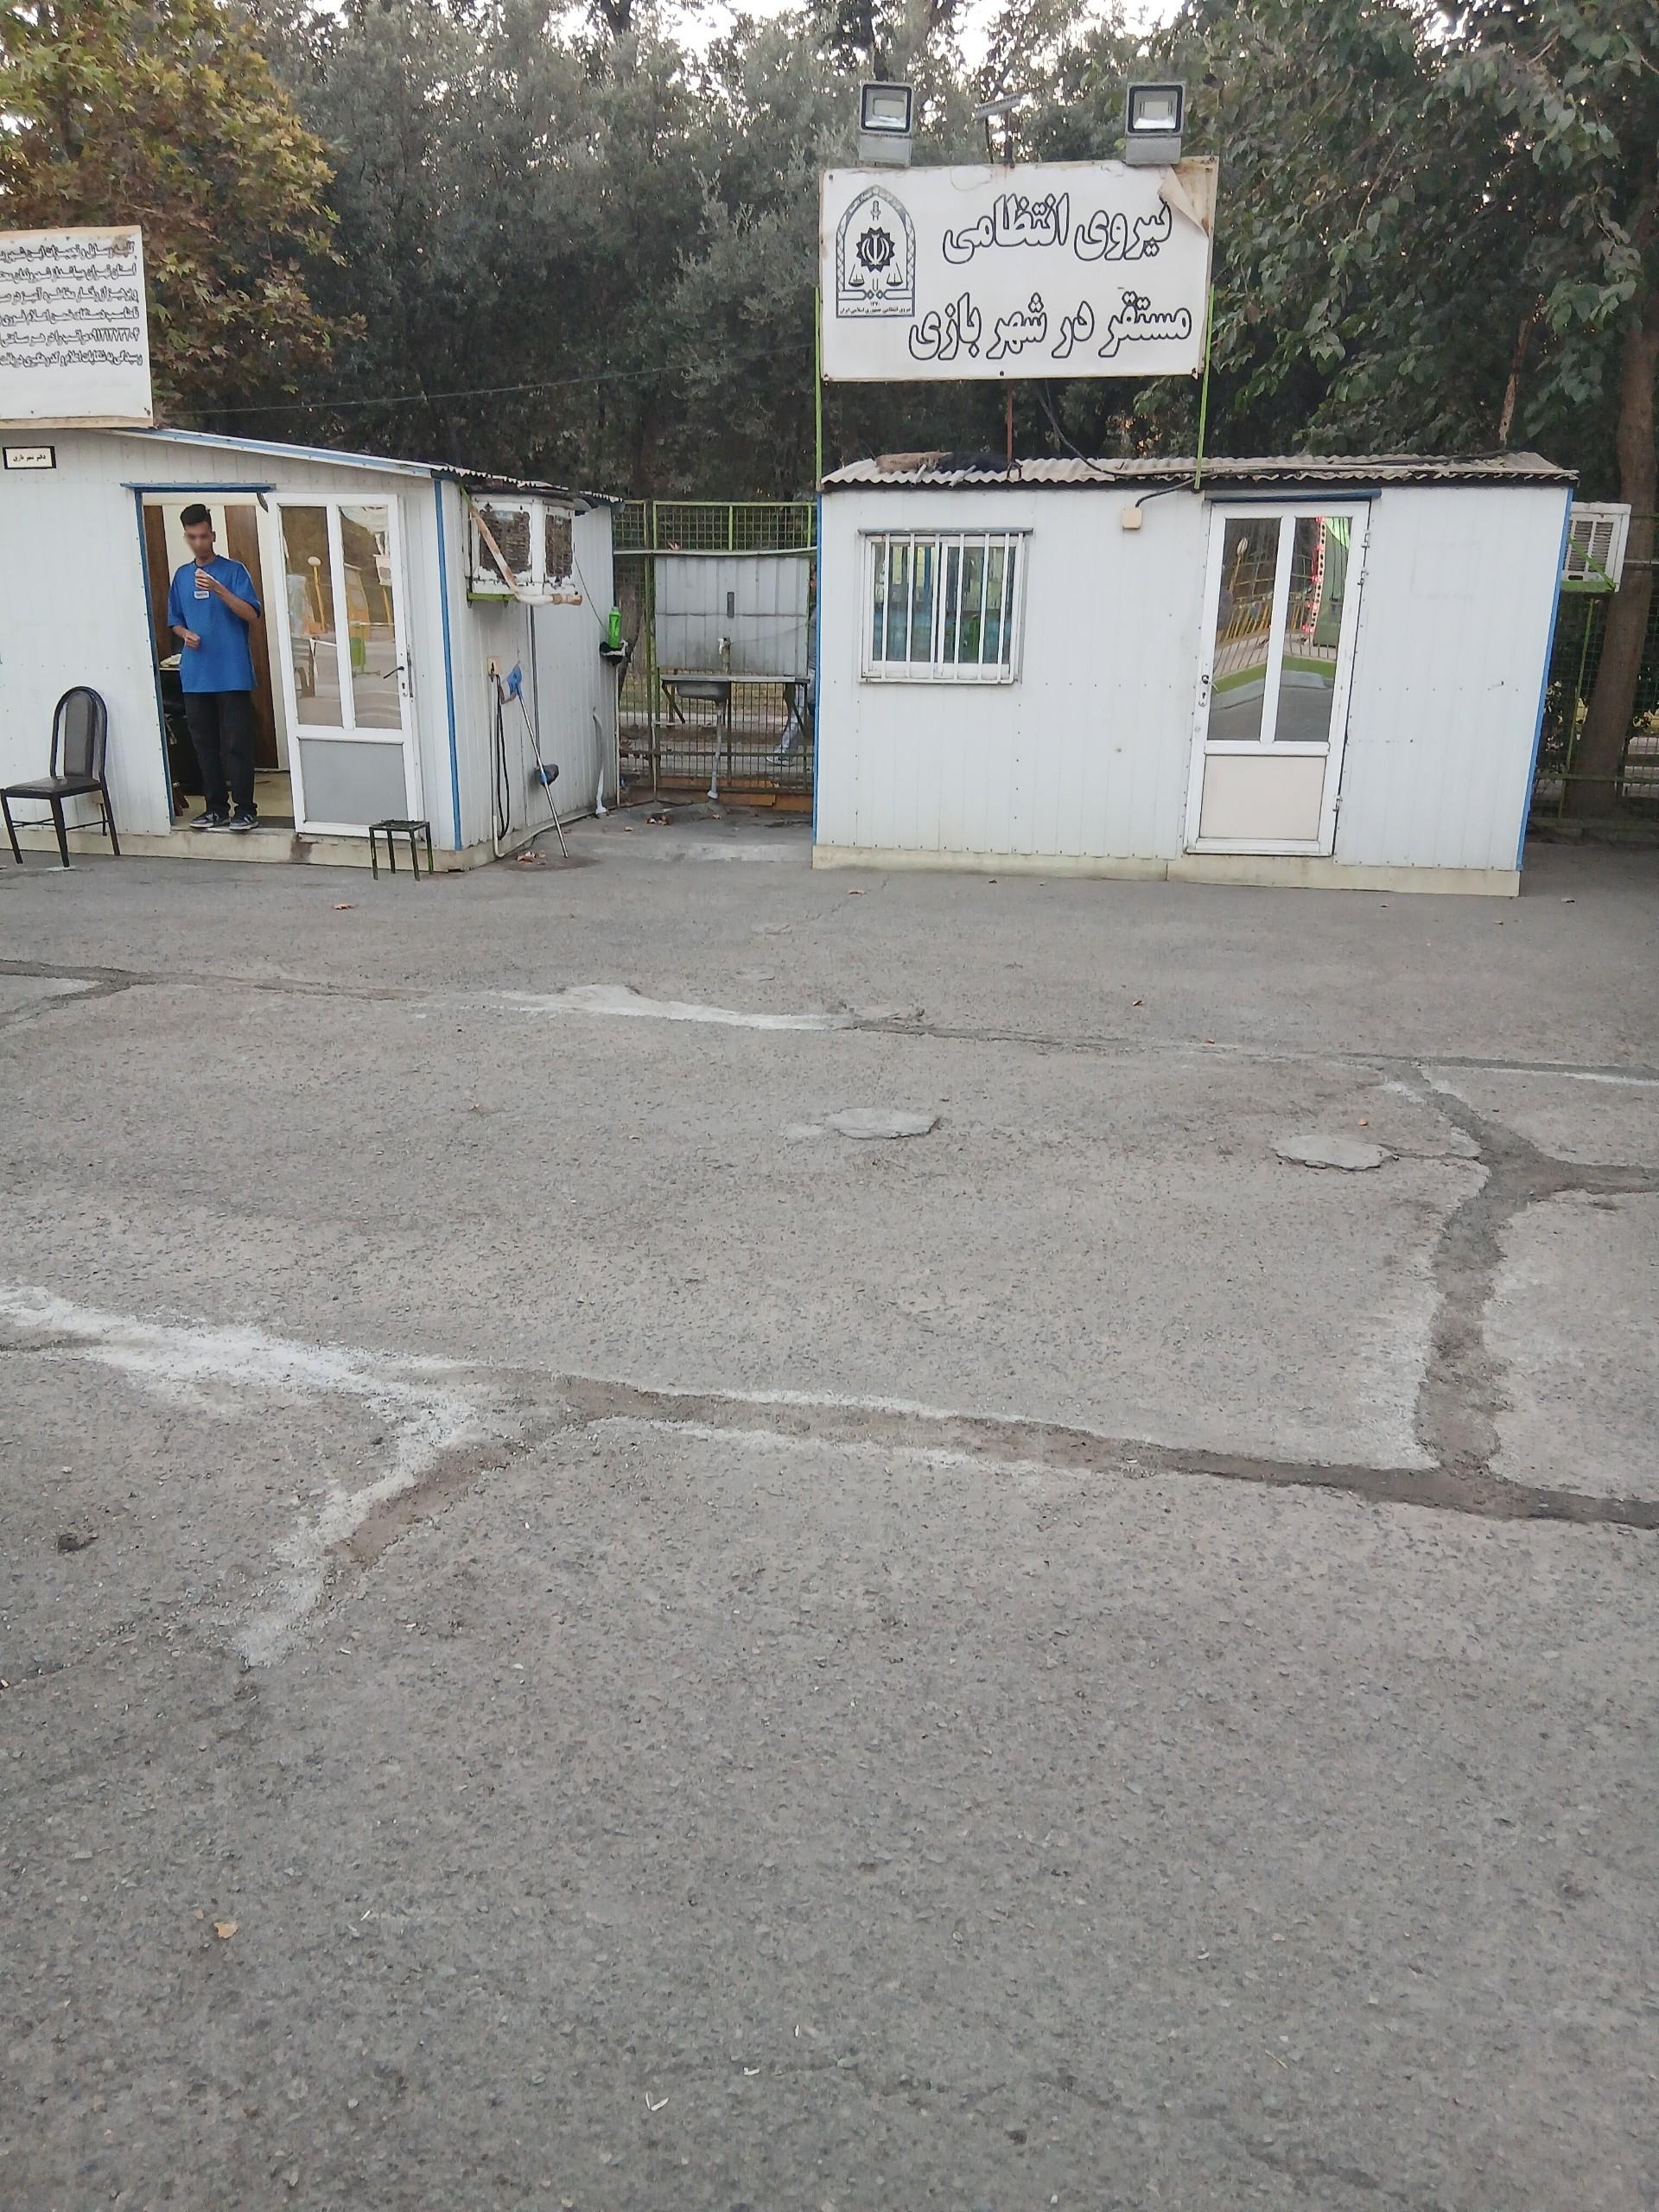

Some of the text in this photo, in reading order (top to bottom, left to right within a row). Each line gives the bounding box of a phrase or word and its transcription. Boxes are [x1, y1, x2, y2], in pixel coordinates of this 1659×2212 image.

[943, 193, 1069, 264] انتظامی
[909, 290, 1192, 360] مستقر در شهر بازی
